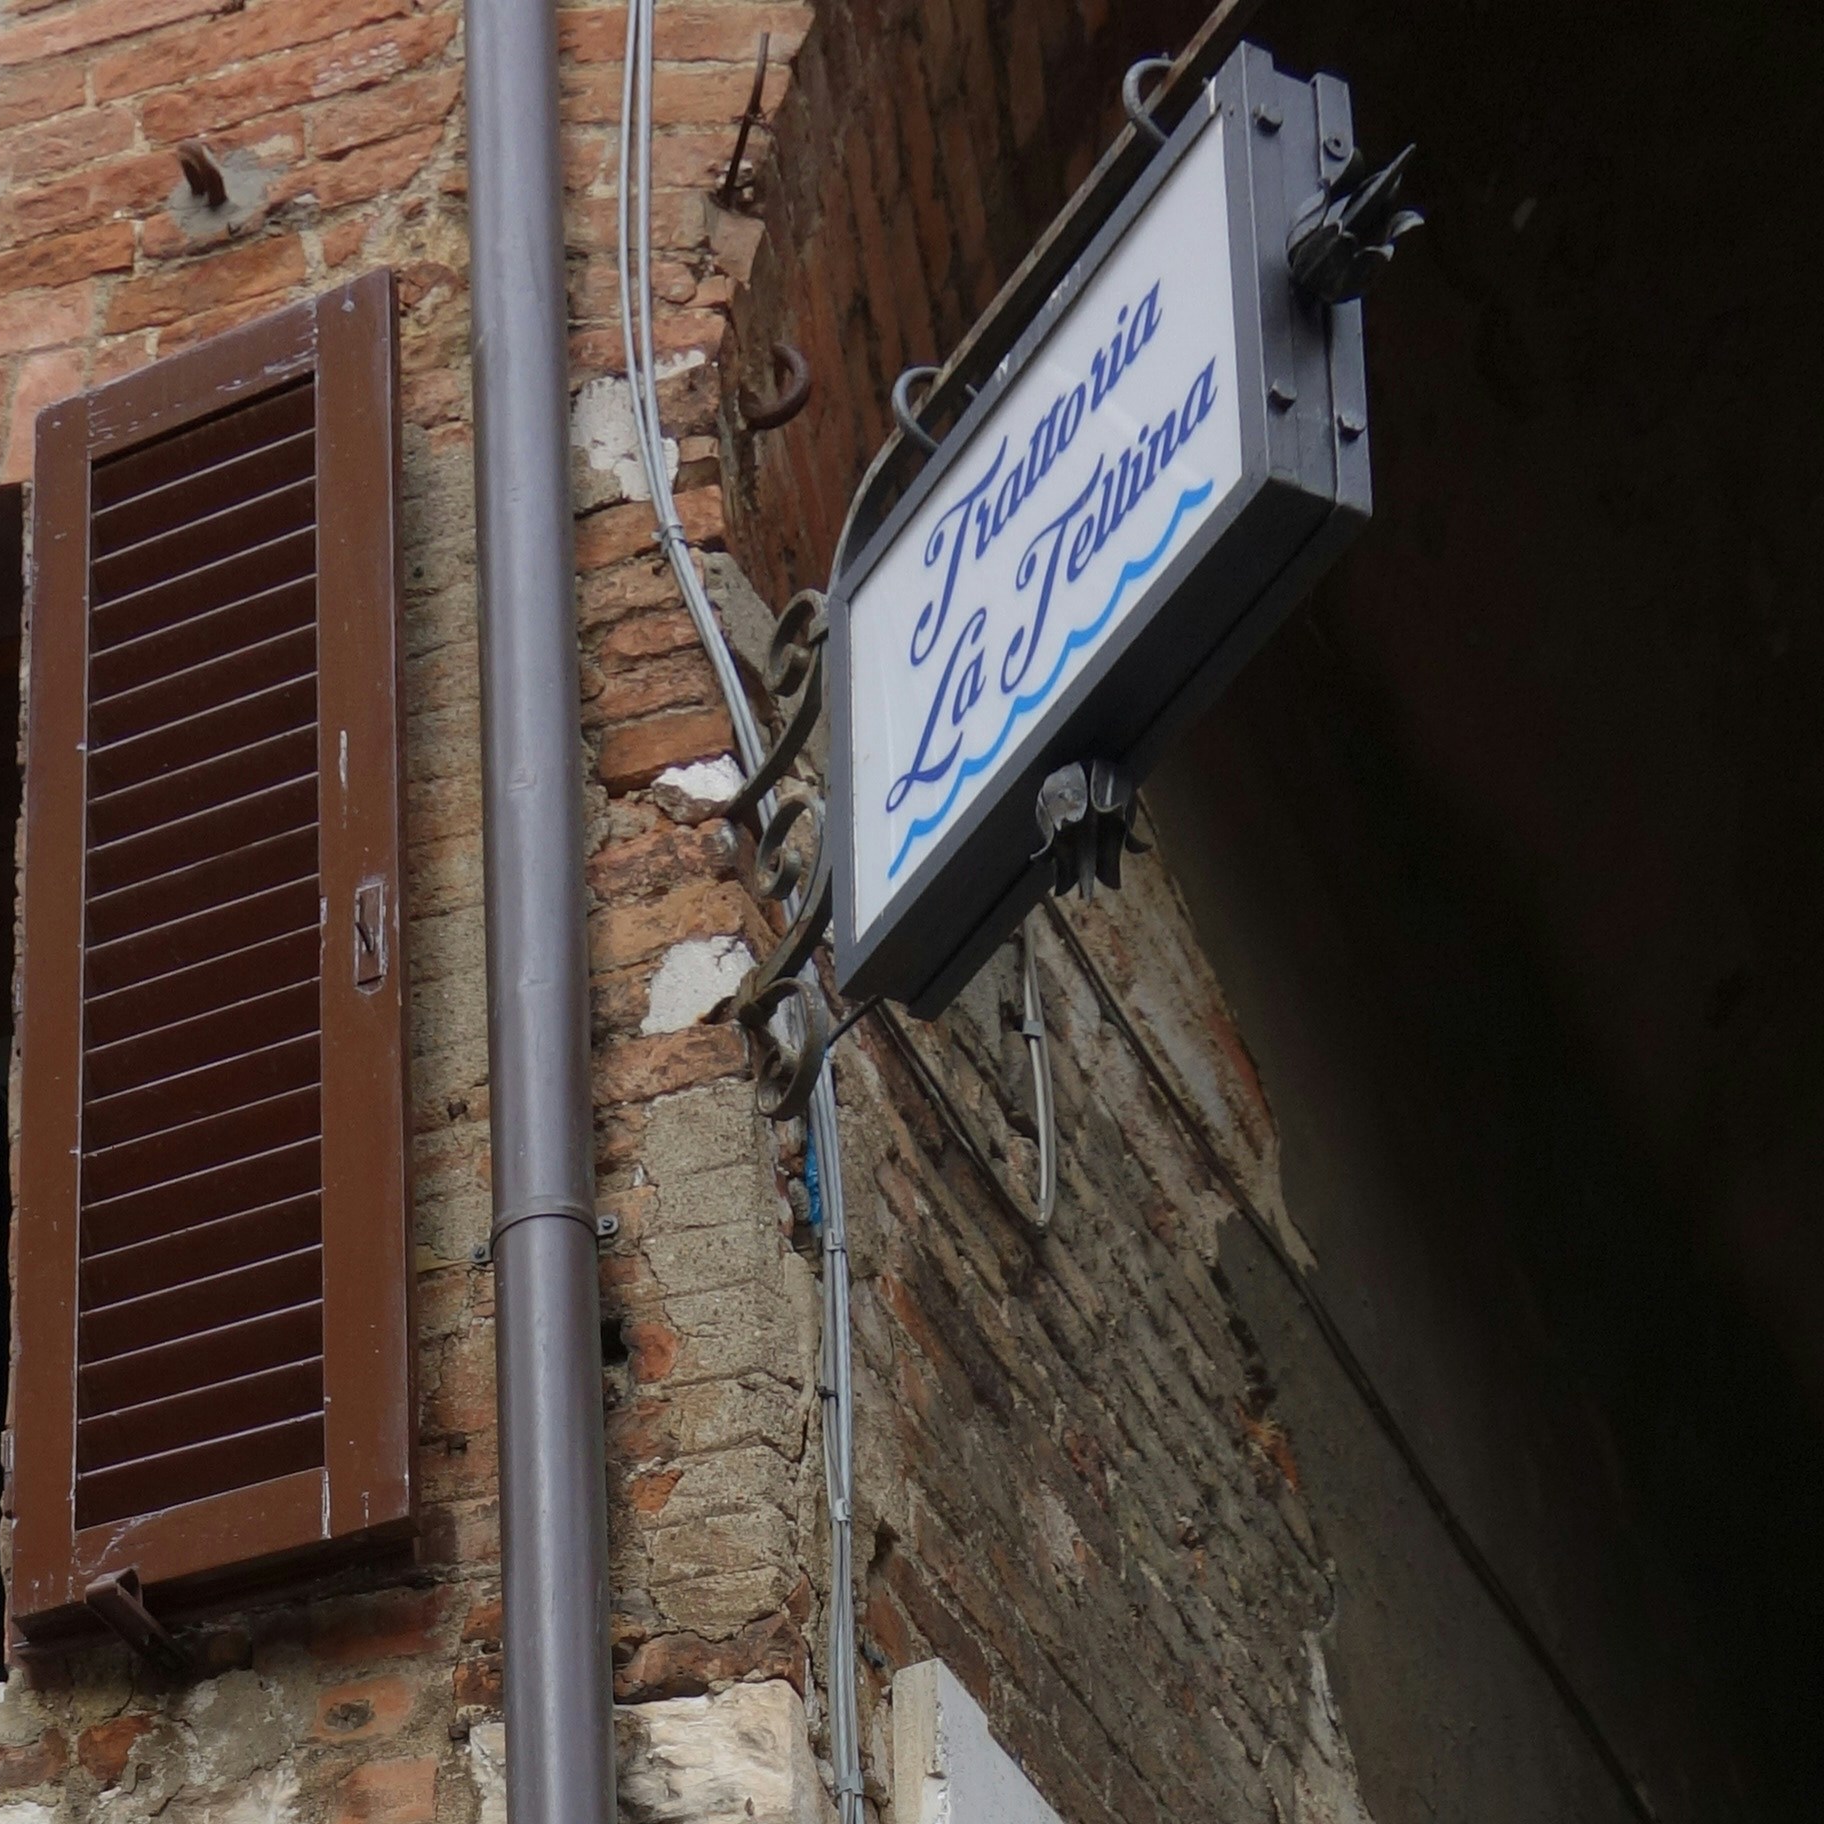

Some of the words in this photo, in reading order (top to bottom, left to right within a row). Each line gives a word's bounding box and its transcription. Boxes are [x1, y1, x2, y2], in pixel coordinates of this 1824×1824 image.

[885, 606, 987, 813] La
[999, 354, 1219, 696] Tellina
[910, 277, 1164, 667] Trattoria
